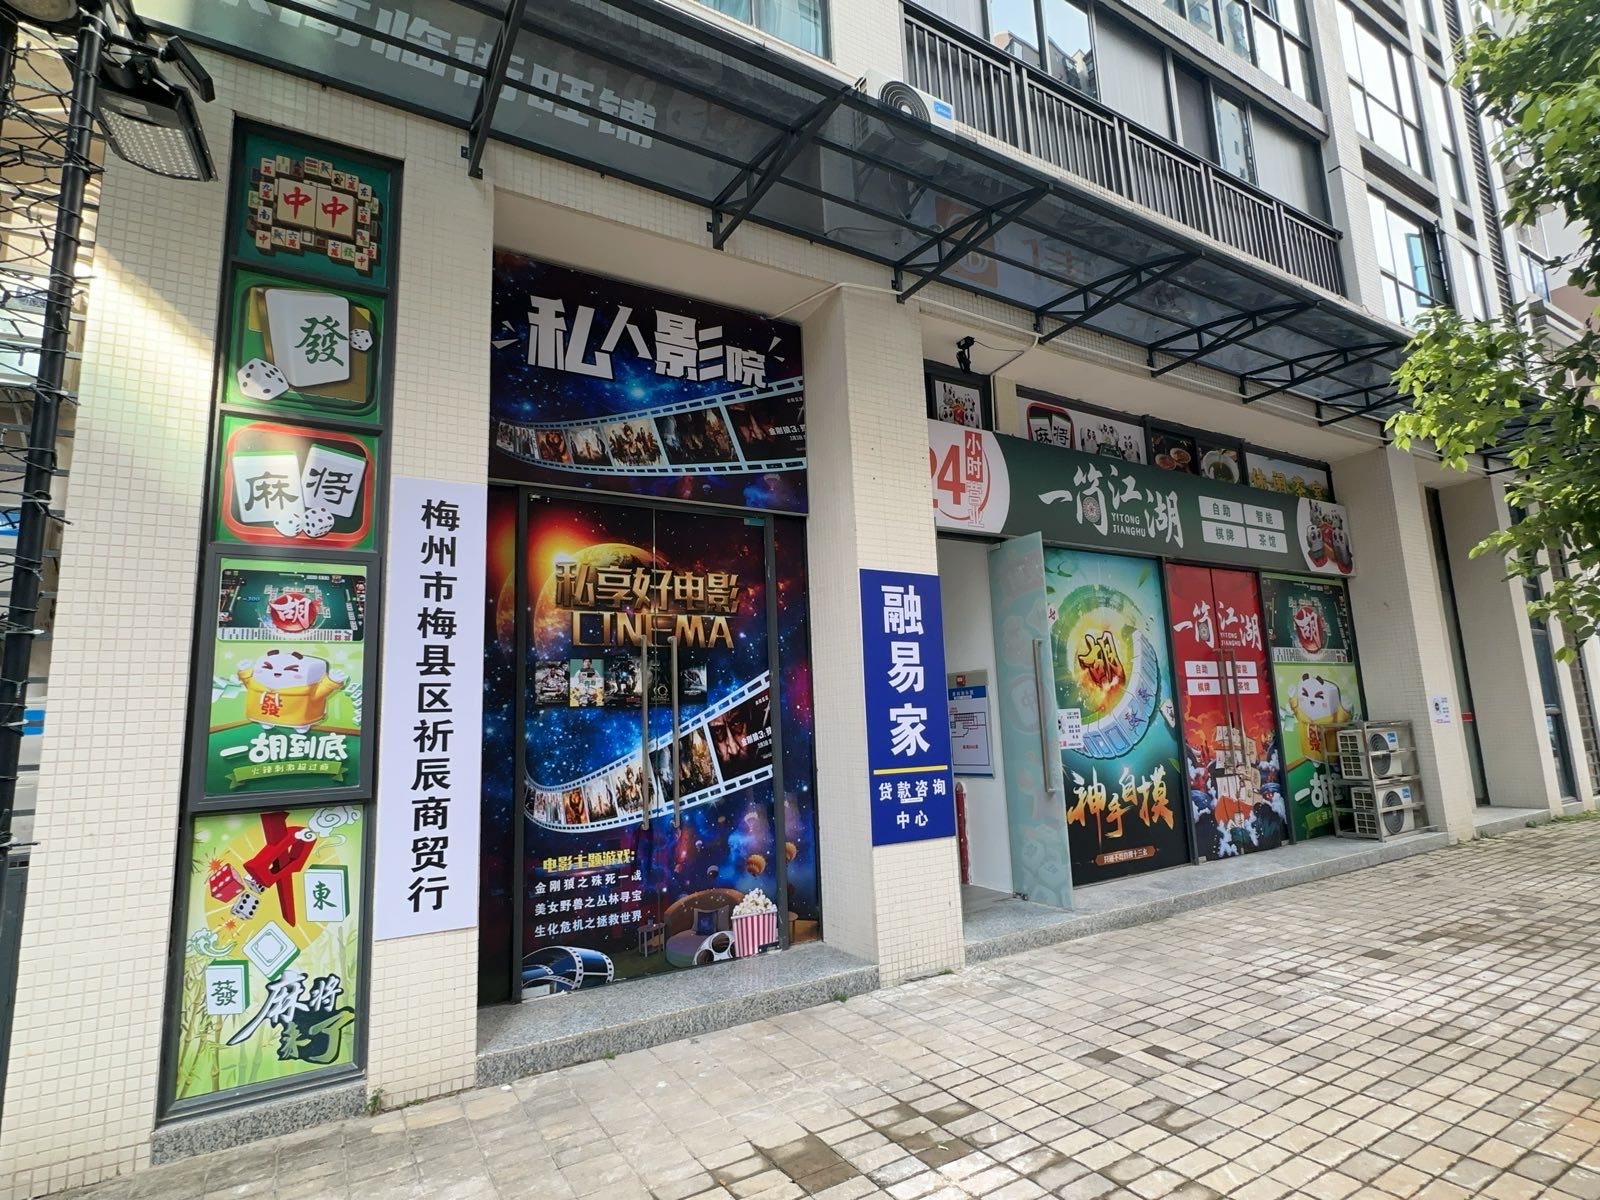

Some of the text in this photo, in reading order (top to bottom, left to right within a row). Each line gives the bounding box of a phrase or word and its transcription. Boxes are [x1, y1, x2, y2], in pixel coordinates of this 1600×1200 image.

[236, 0, 658, 150] 高临街旺铺
[294, 315, 349, 367] 發
[526, 294, 768, 389] 私人影院
[1034, 425, 1069, 446] 麻将
[243, 466, 353, 512] 麻将
[966, 433, 985, 528] 小时营业
[1111, 512, 1140, 525] YITONG
[1112, 524, 1146, 537] JIANGHU
[1212, 502, 1274, 525] 自助 智能
[1215, 526, 1277, 548] 棋牌 茶馆
[554, 562, 741, 613] 私享好电影
[271, 596, 314, 630] 胡
[570, 610, 735, 648] CINEMA
[1294, 608, 1322, 649] 胡
[881, 584, 931, 757] 融易家
[1078, 630, 1127, 689] 胡
[407, 499, 460, 912] 梅州市梅县区祈辰商贸行
[219, 732, 349, 764] 一胡到底
[878, 778, 947, 802] 贷款咨询
[1067, 763, 1175, 842] 神手自摸
[896, 810, 929, 830] 中心
[542, 848, 635, 873] 电影主题游戏:
[312, 880, 338, 910] 東
[534, 869, 642, 895] 金刚狼之殊死一战
[534, 889, 642, 917] 美女野兽之丛林寻宝
[534, 909, 642, 938] 生化危机之拯救世界
[226, 971, 346, 1046] 麻将
[277, 1010, 355, 1064] 来了
